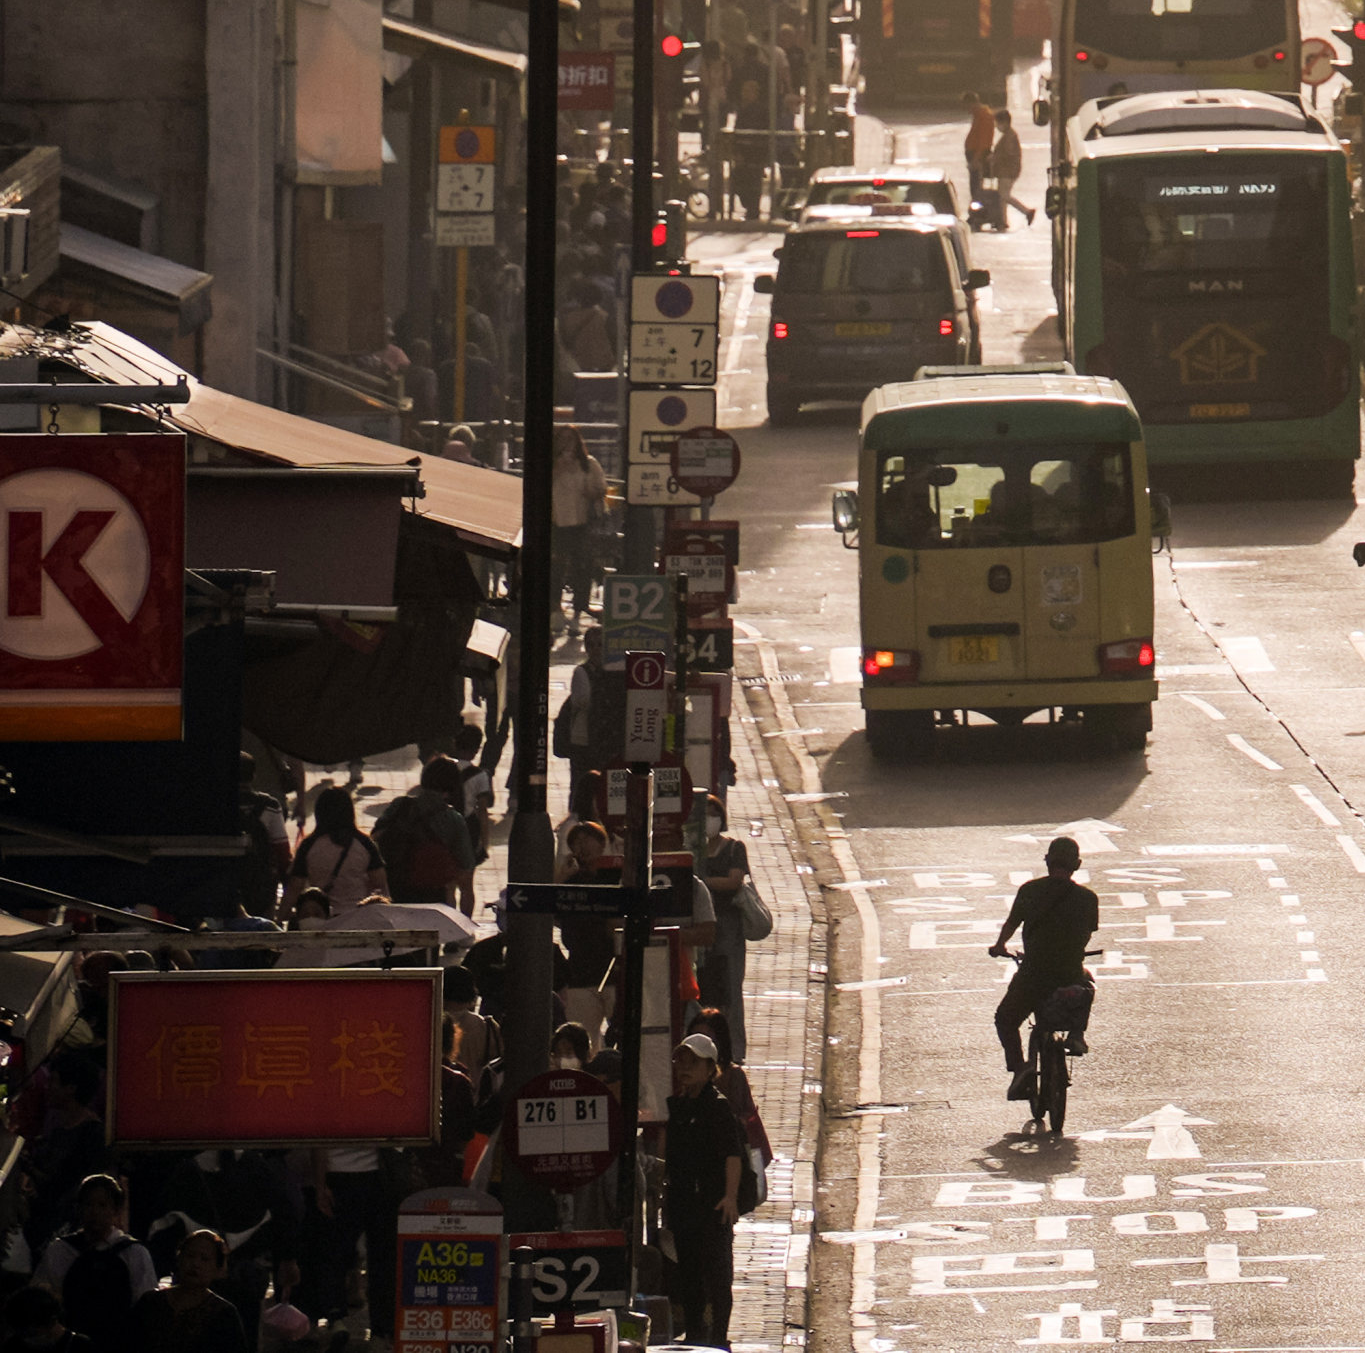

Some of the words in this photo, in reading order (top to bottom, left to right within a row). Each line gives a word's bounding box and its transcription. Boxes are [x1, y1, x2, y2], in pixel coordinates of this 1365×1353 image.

[475, 168, 485, 184] 7
[475, 192, 484, 208] 7
[1188, 280, 1243, 293] MAN
[689, 329, 704, 349] 7
[690, 359, 713, 379] 12
[640, 472, 660, 481] am
[611, 581, 665, 620] B2
[630, 707, 644, 744] Yuen
[645, 708, 659, 744] Long
[525, 1101, 556, 1124] 276
[575, 1099, 597, 1120] B1
[933, 1172, 1269, 1207] BUS
[893, 1205, 1319, 1245] STOP
[416, 1242, 469, 1267] A36
[417, 1269, 457, 1284] NA36
[531, 1256, 600, 1303] S2
[909, 1243, 1326, 1295] 巴士
[403, 1309, 444, 1329] E36
[1016, 1299, 1217, 1347] 站
